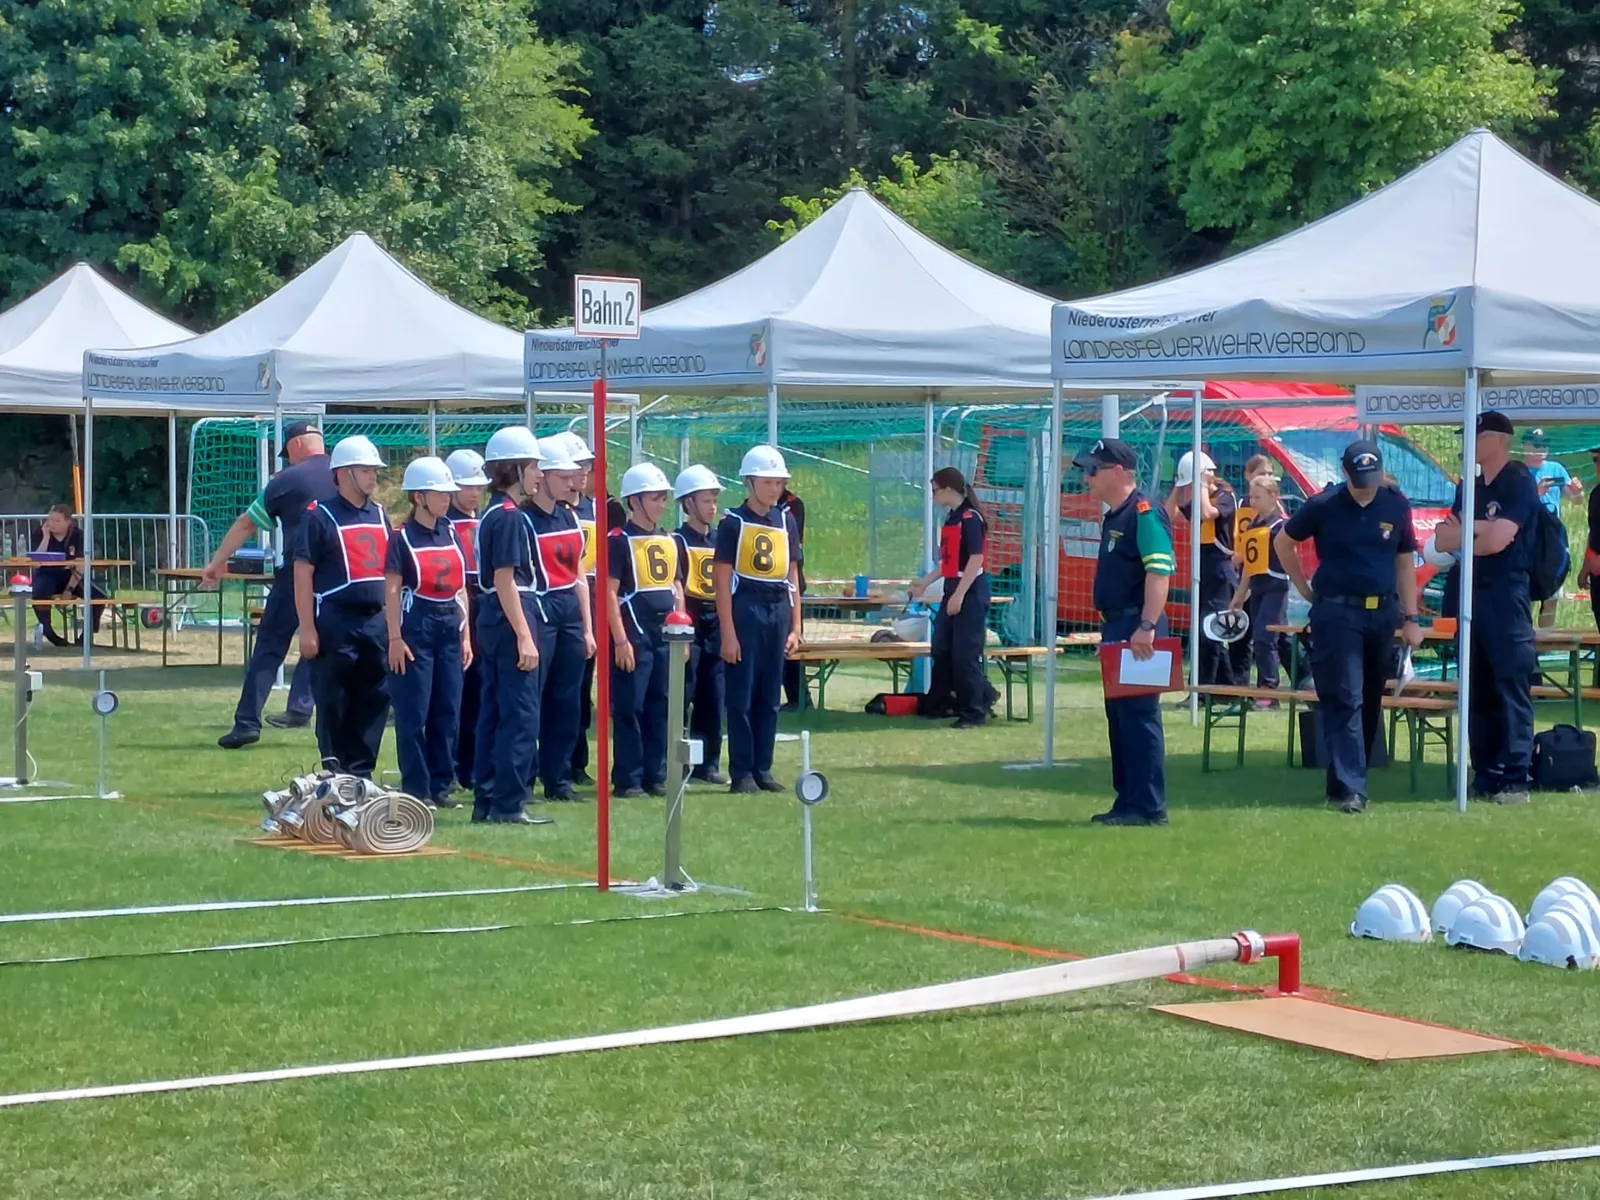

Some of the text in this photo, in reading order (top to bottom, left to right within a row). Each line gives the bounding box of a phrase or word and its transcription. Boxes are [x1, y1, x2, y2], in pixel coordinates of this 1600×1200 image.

[581, 288, 635, 326] Bahn 2
[356, 533, 379, 568] 3
[555, 542, 574, 571] 4
[646, 543, 669, 583] 6
[752, 532, 775, 574] 8
[1246, 537, 1258, 563] 6
[432, 558, 452, 592] 2
[698, 556, 715, 594] 9
